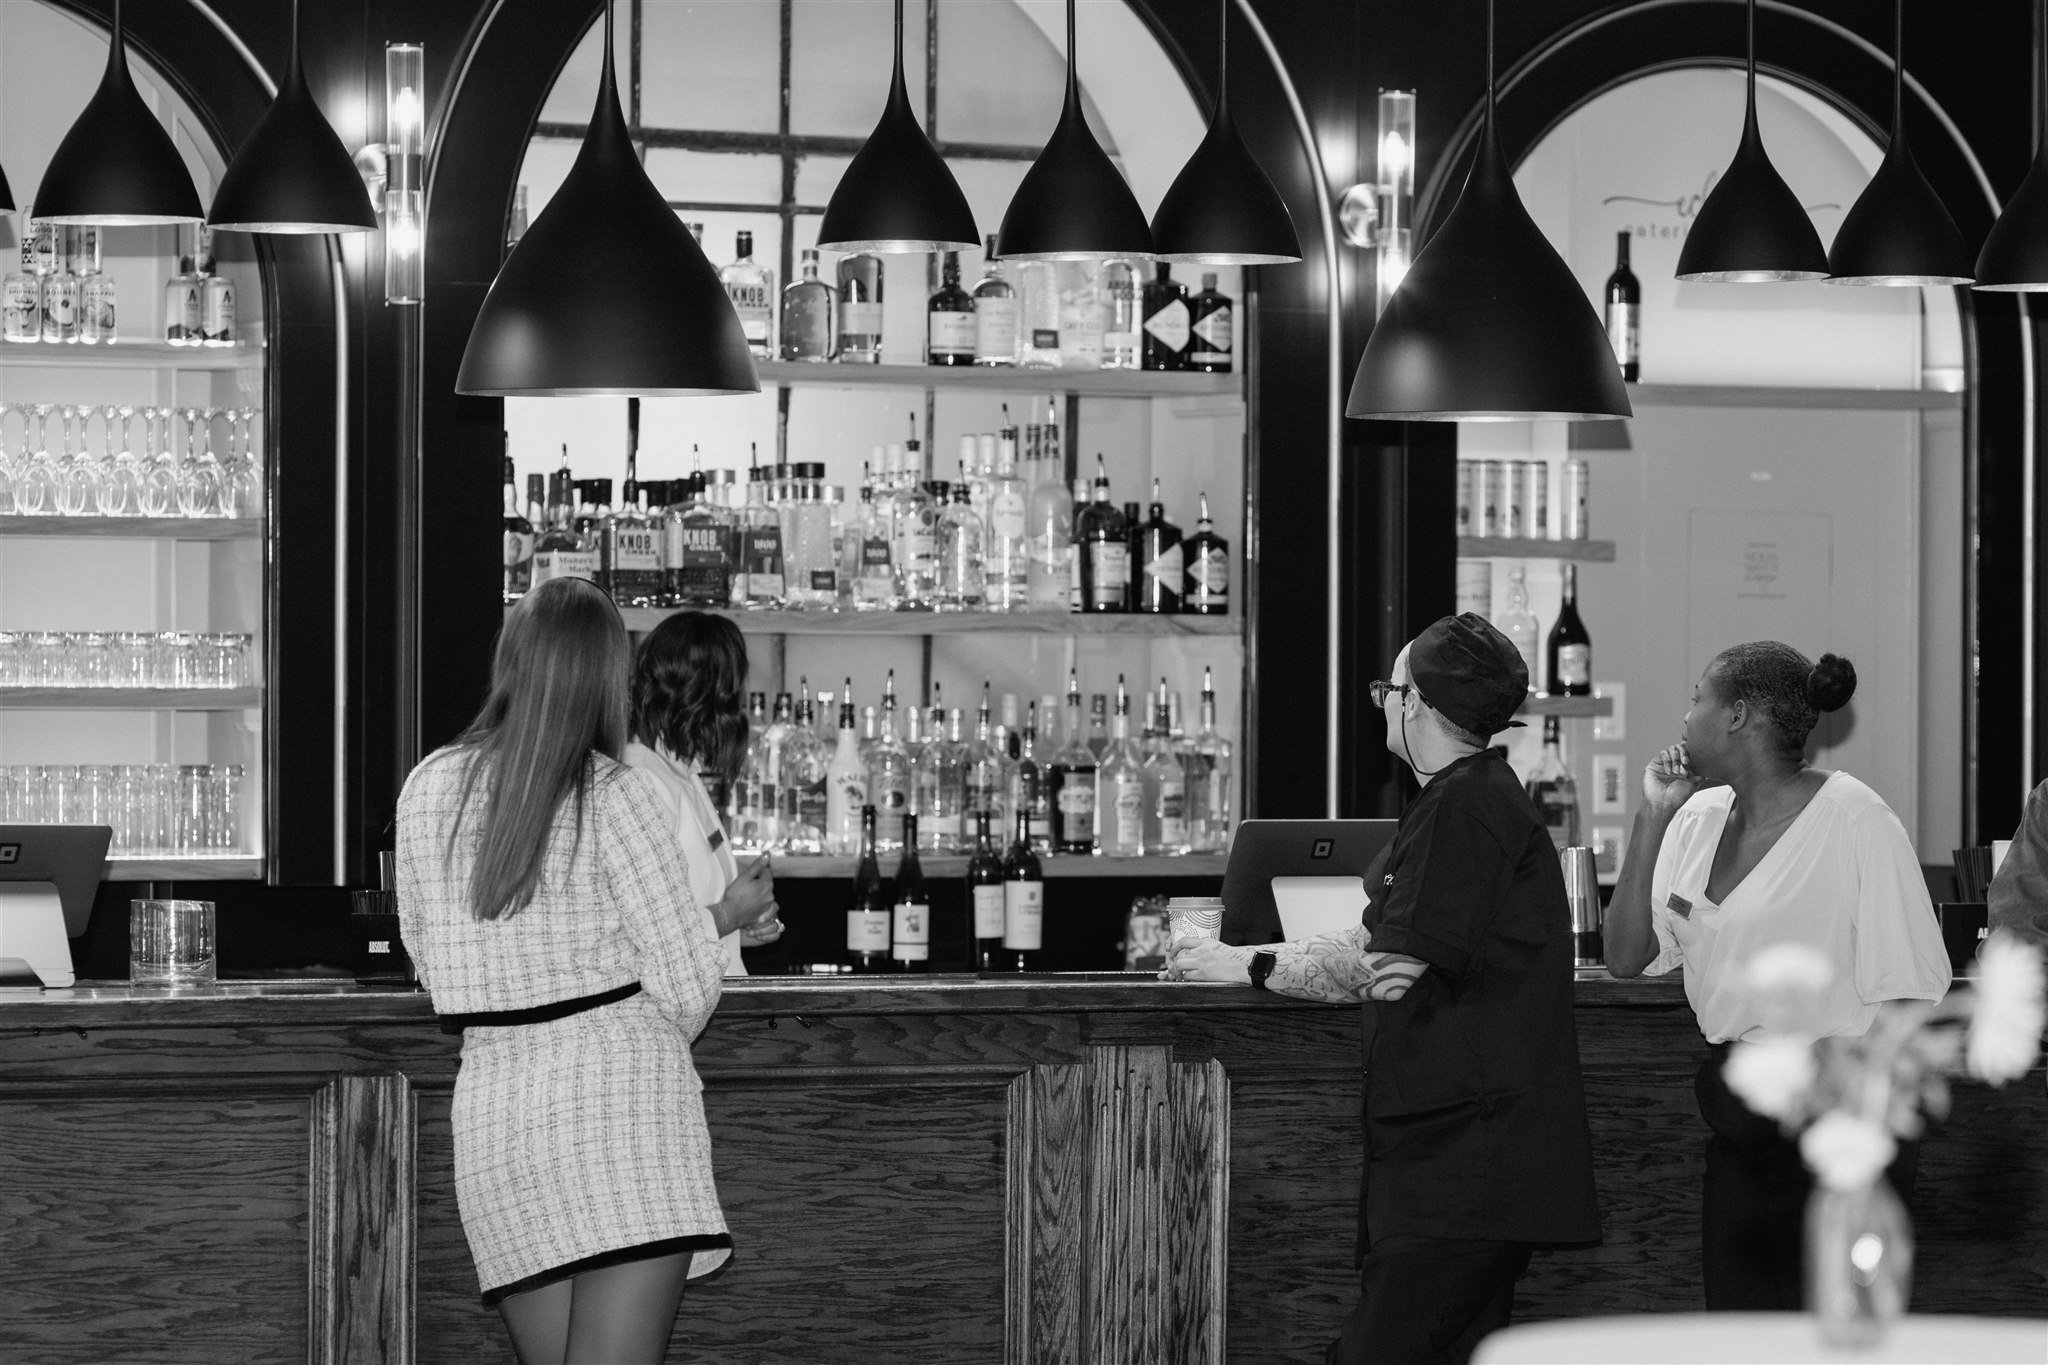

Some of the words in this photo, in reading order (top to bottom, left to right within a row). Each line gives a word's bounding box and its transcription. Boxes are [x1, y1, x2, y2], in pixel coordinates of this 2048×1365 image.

[732, 287, 764, 302] KNOB
[619, 535, 651, 549] KNOB
[683, 529, 717, 545] KNOB
